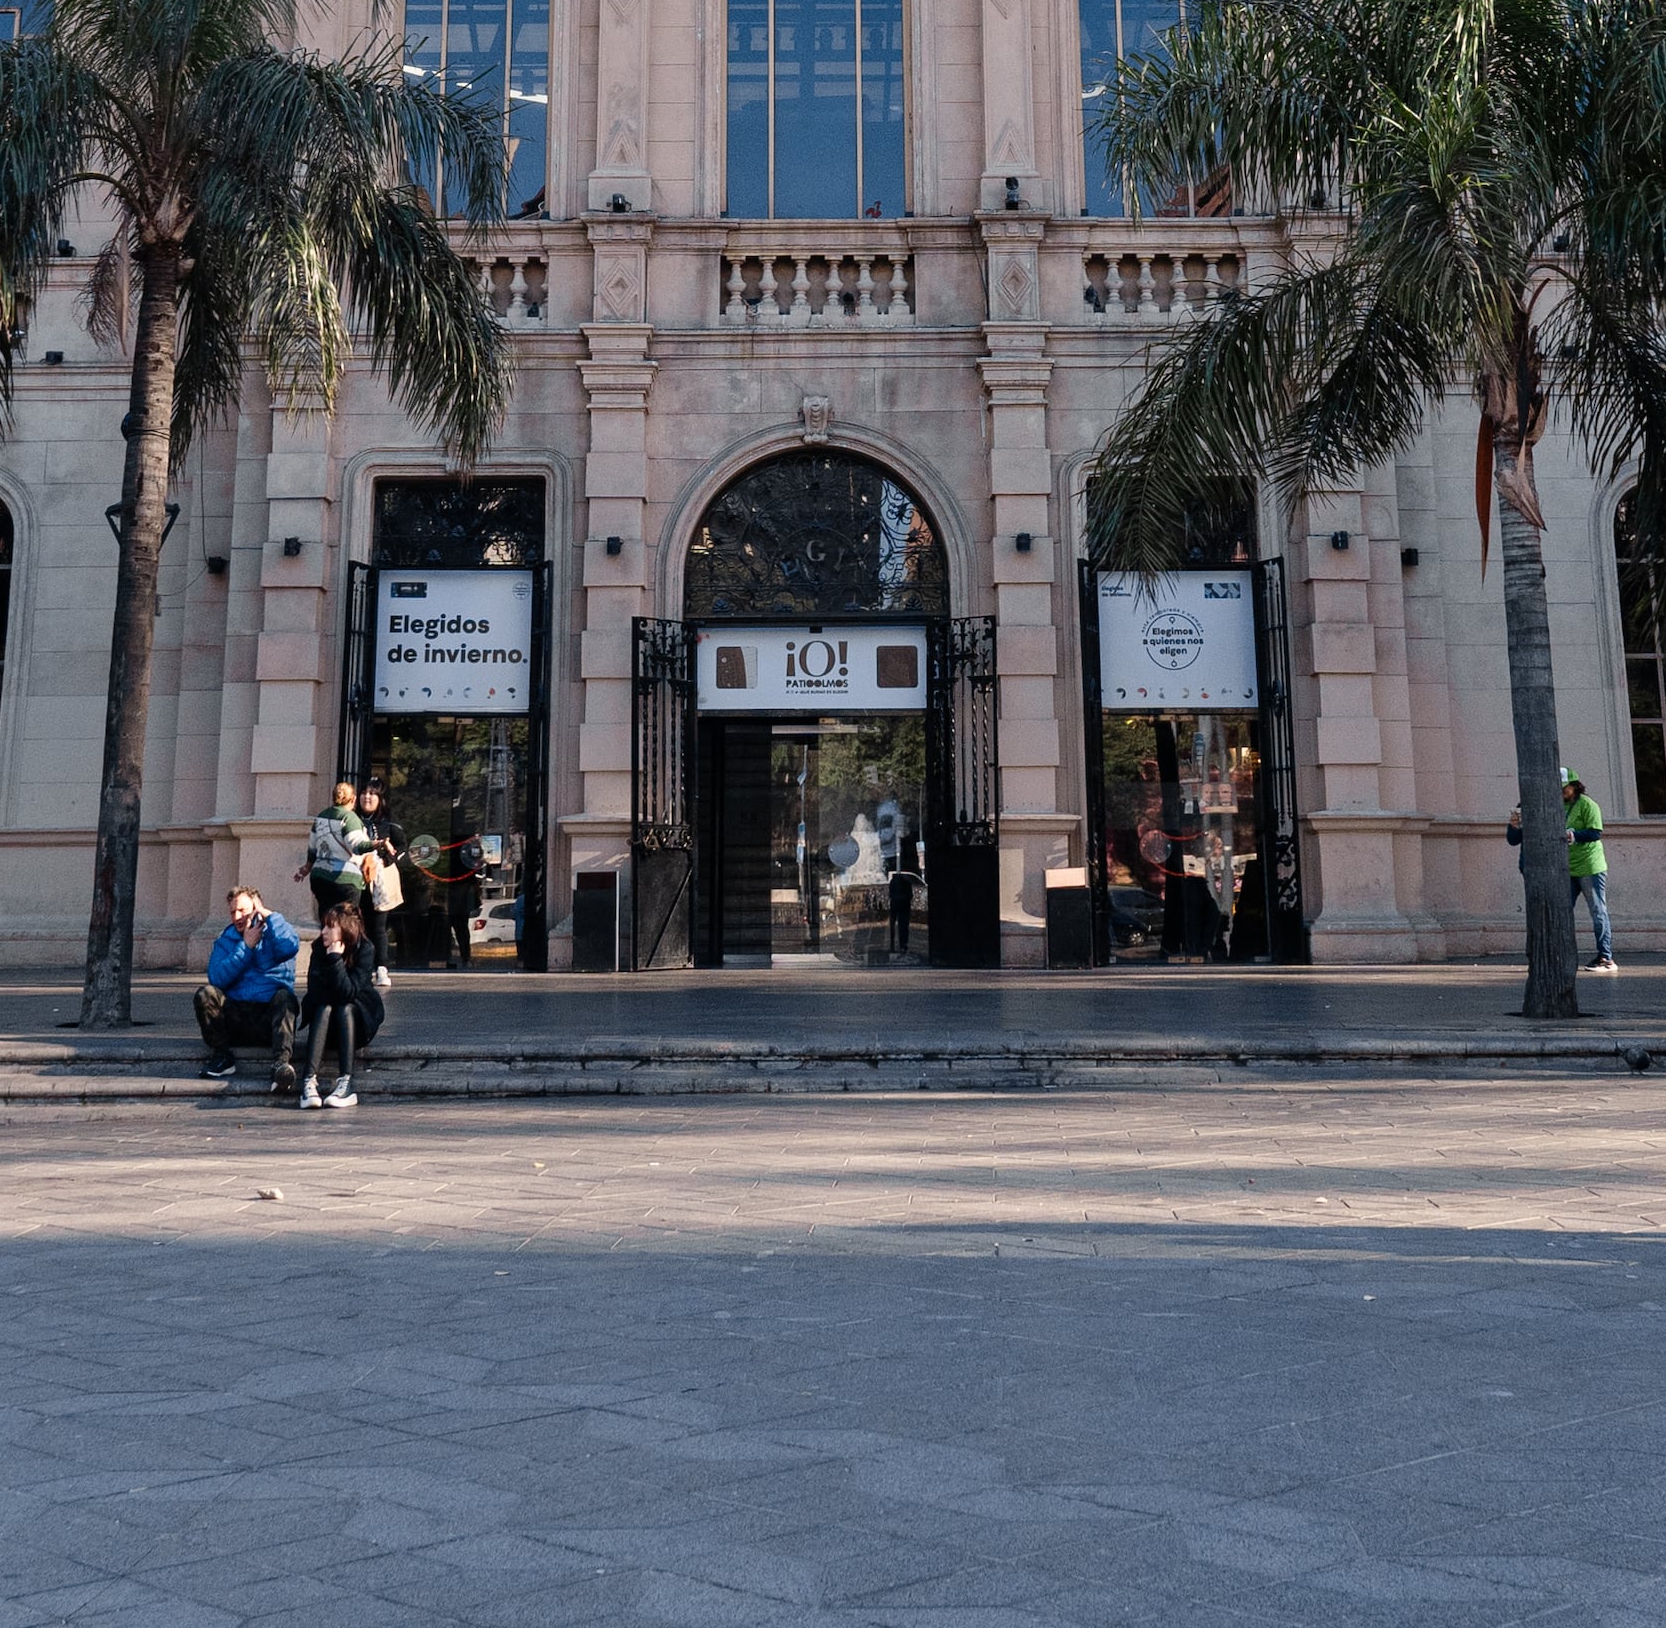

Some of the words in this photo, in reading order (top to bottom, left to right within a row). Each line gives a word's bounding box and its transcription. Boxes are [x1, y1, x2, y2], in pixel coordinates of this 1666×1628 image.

[389, 613, 490, 640] Elegidos
[1152, 627, 1193, 637] Elegimos
[1150, 636, 1186, 646] quienes
[387, 644, 418, 664] de
[424, 643, 528, 664] invierno.
[1159, 646, 1187, 657] eligen
